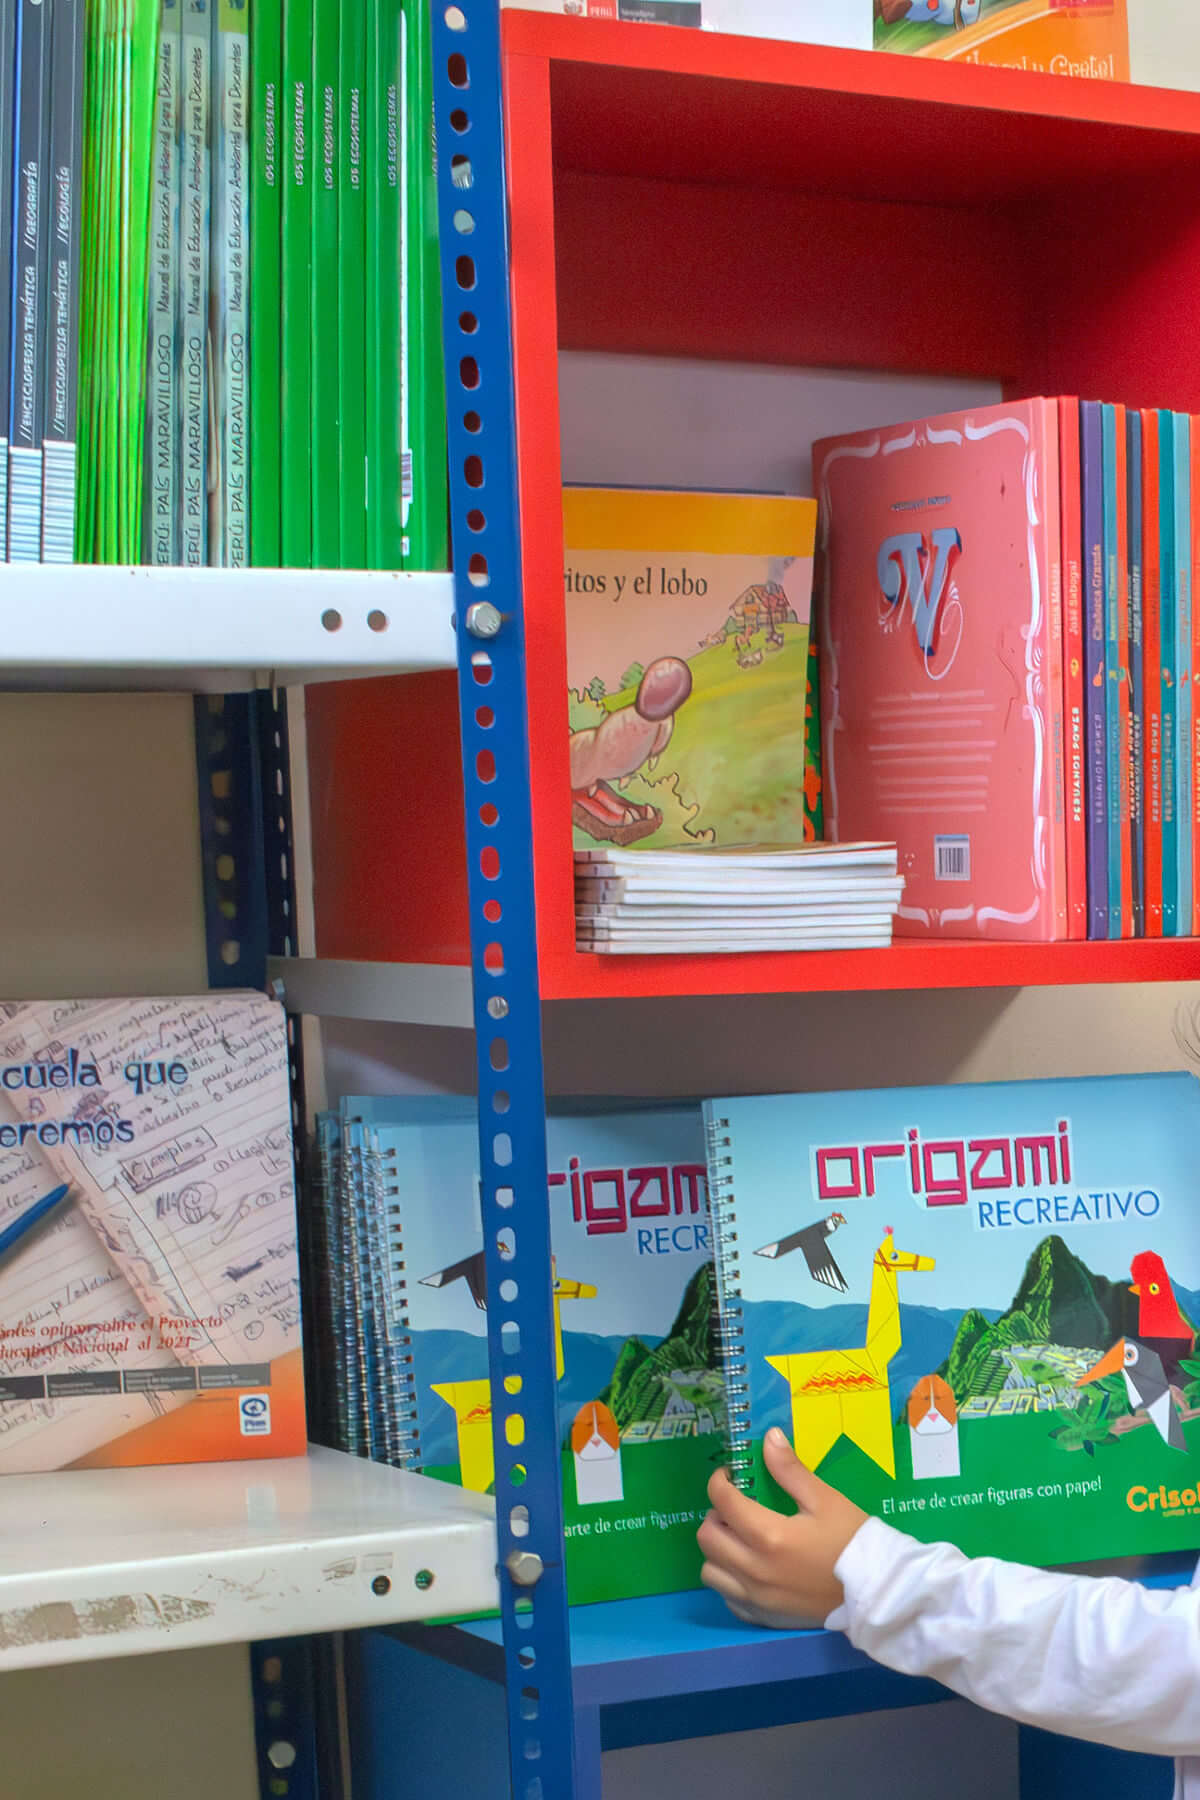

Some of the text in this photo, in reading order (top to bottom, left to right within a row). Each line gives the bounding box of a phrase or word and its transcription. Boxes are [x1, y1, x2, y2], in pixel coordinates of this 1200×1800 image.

[266, 164, 274, 186] LOS
[295, 163, 304, 185] LOS
[324, 167, 333, 189] LOS
[388, 165, 396, 187] LOS
[19, 265, 35, 331] TEMÁTICA
[52, 260, 68, 326] TEMÁTICA
[158, 334, 171, 468] MARAVILLOSO
[188, 336, 201, 470] MARAVILLOSO
[231, 333, 244, 467] MARAVILLOSO
[154, 477, 170, 516] PAÍS
[184, 477, 201, 516] PAÍS
[228, 473, 244, 513] PAÍS
[154, 522, 170, 566] ERÚ:
[184, 522, 200, 567] ERÚ:
[564, 568, 708, 602] itos y el lobo
[1072, 755, 1081, 822] PERUANOS
[2, 1047, 188, 1095] cuela que
[0, 1119, 134, 1147] eremos
[815, 1119, 1072, 1207] origami
[547, 1157, 708, 1236] igam
[978, 1189, 1161, 1228] RECREATIVO
[638, 1224, 709, 1255] RECR
[63, 1337, 128, 1355] Nacional
[138, 1335, 151, 1350] al
[156, 1335, 191, 1350] 2021
[160, 1316, 224, 1335] Proyecto
[882, 1475, 1102, 1514] El arte de crear figuras con papel
[564, 1510, 695, 1537] arte de crear figuras
